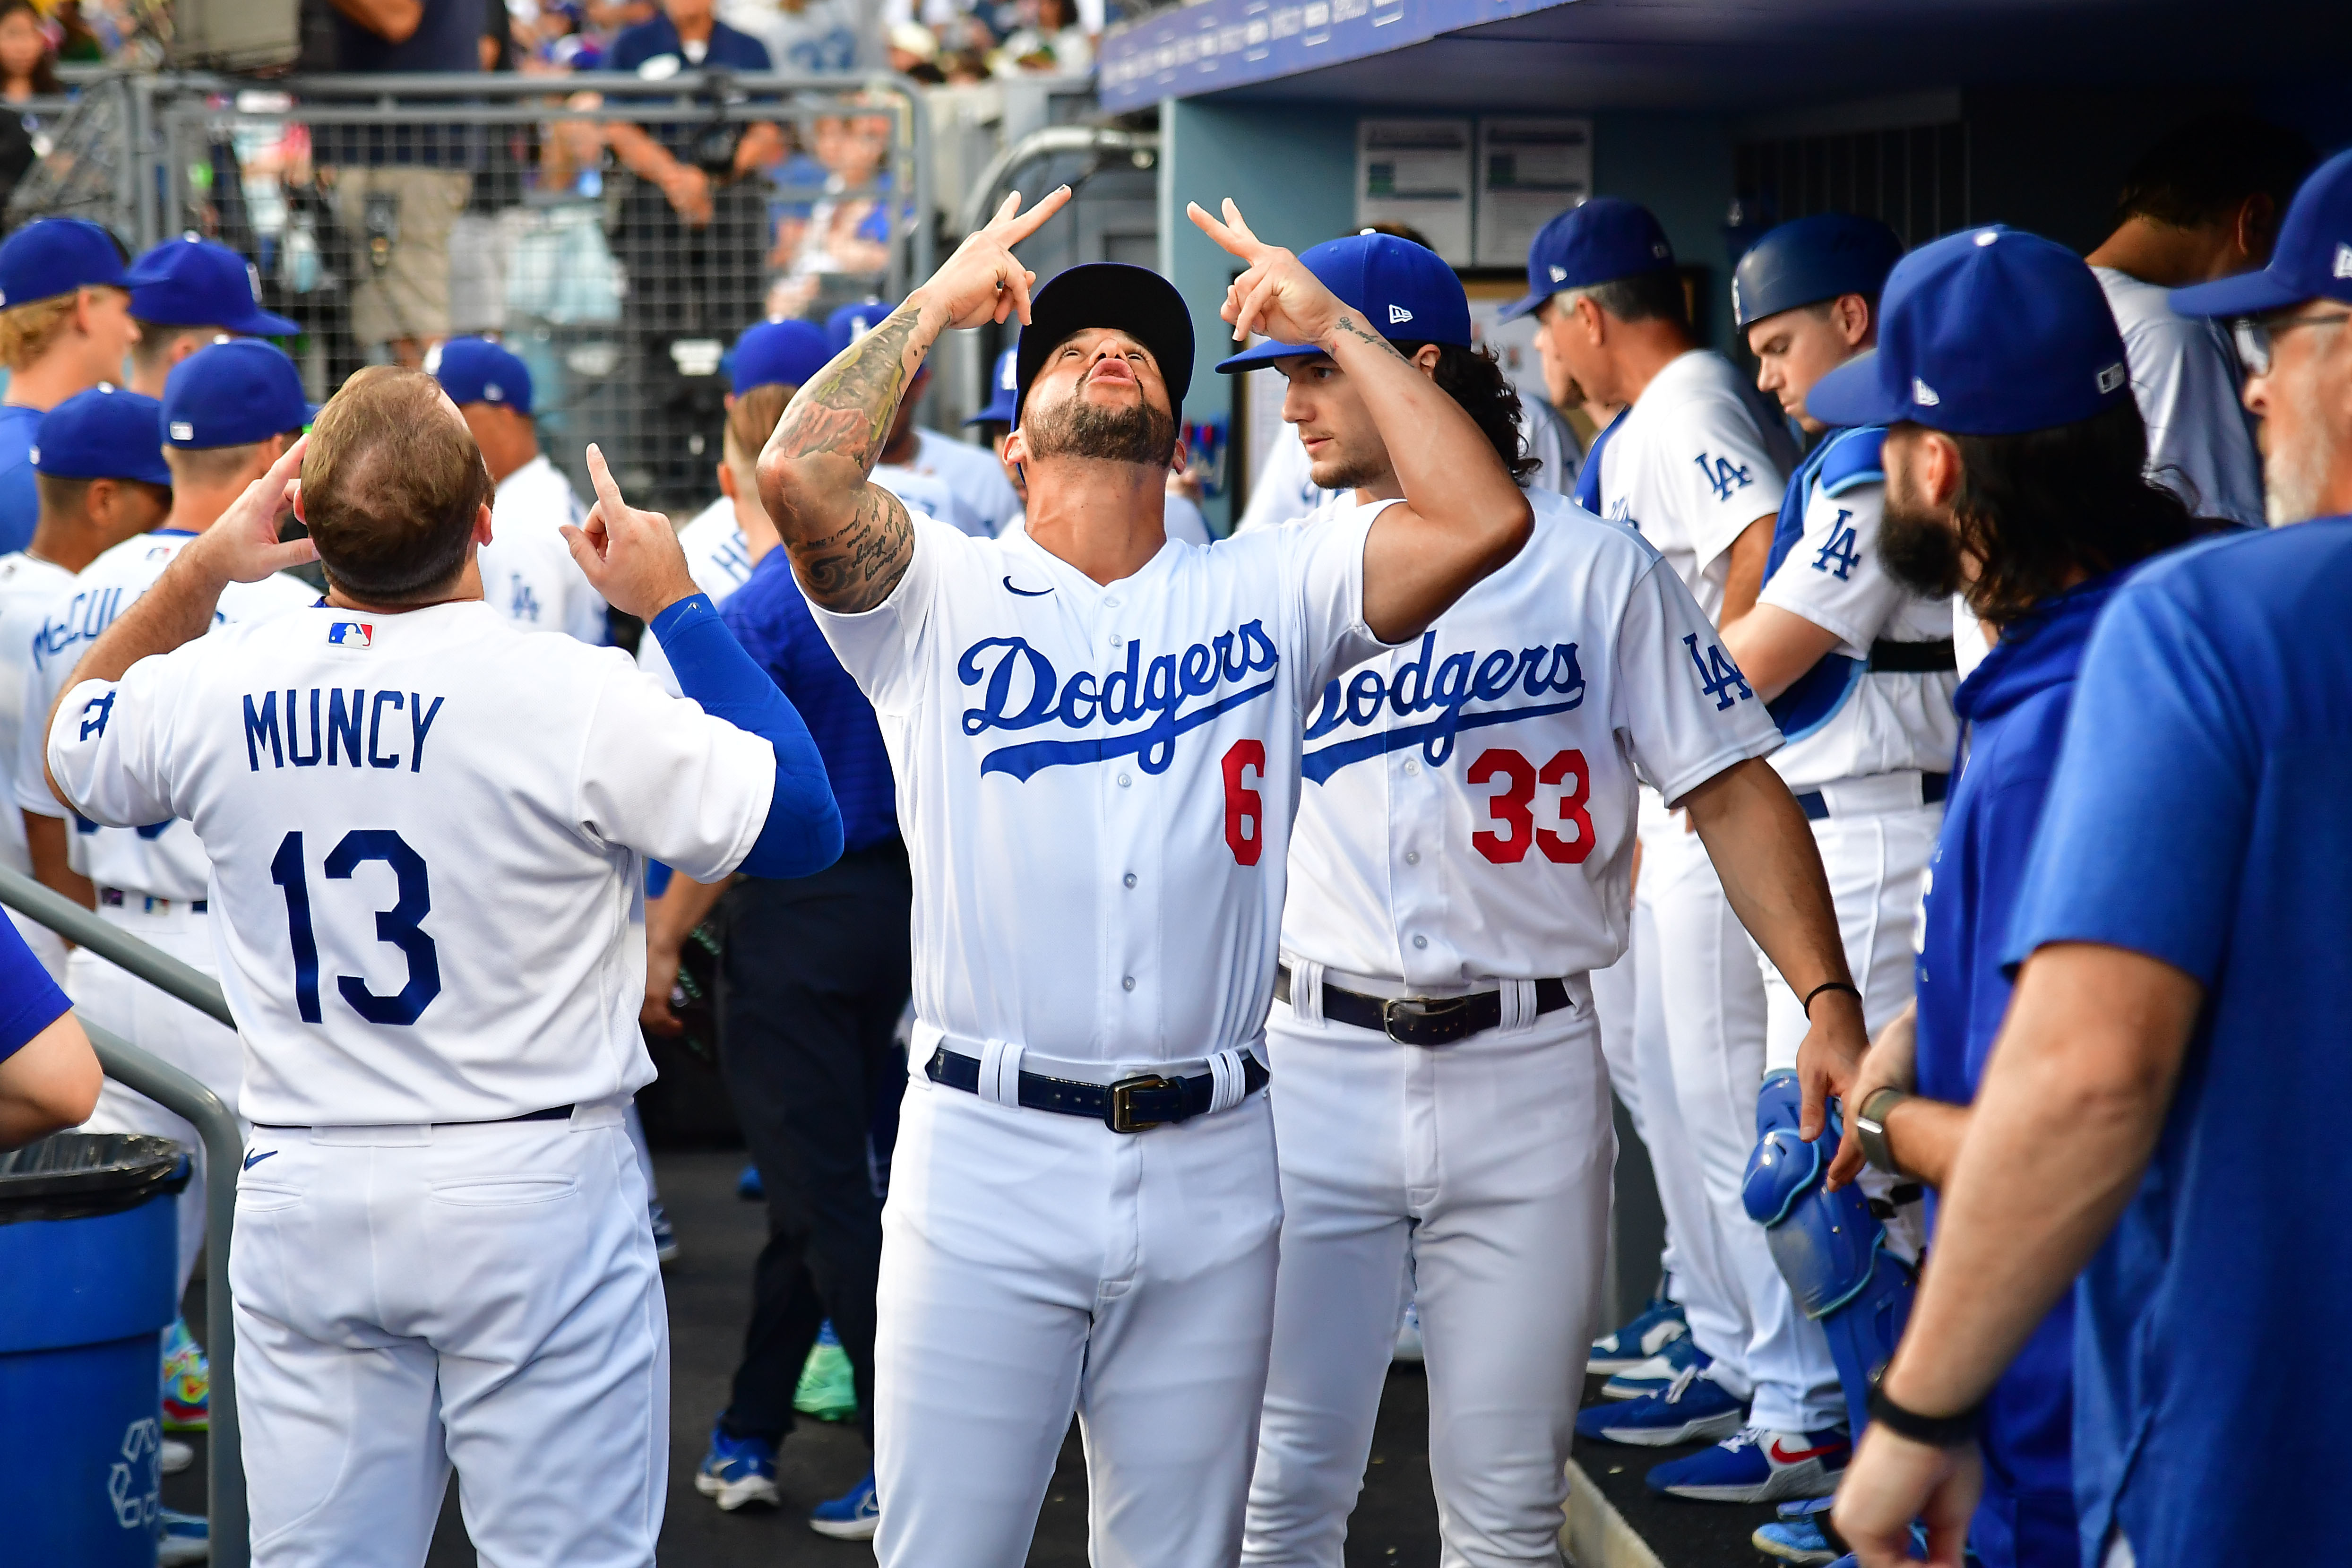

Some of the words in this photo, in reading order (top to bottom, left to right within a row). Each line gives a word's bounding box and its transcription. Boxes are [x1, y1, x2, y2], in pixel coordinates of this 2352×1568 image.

[1694, 451, 1752, 502] LA
[1812, 509, 1861, 581] LA
[957, 619, 1279, 775] Dodgers
[1683, 632, 1753, 711] LA
[243, 688, 445, 773] MUNCY
[1221, 739, 1266, 866] 6
[1467, 748, 1596, 864] 33
[270, 829, 441, 1025] 13
